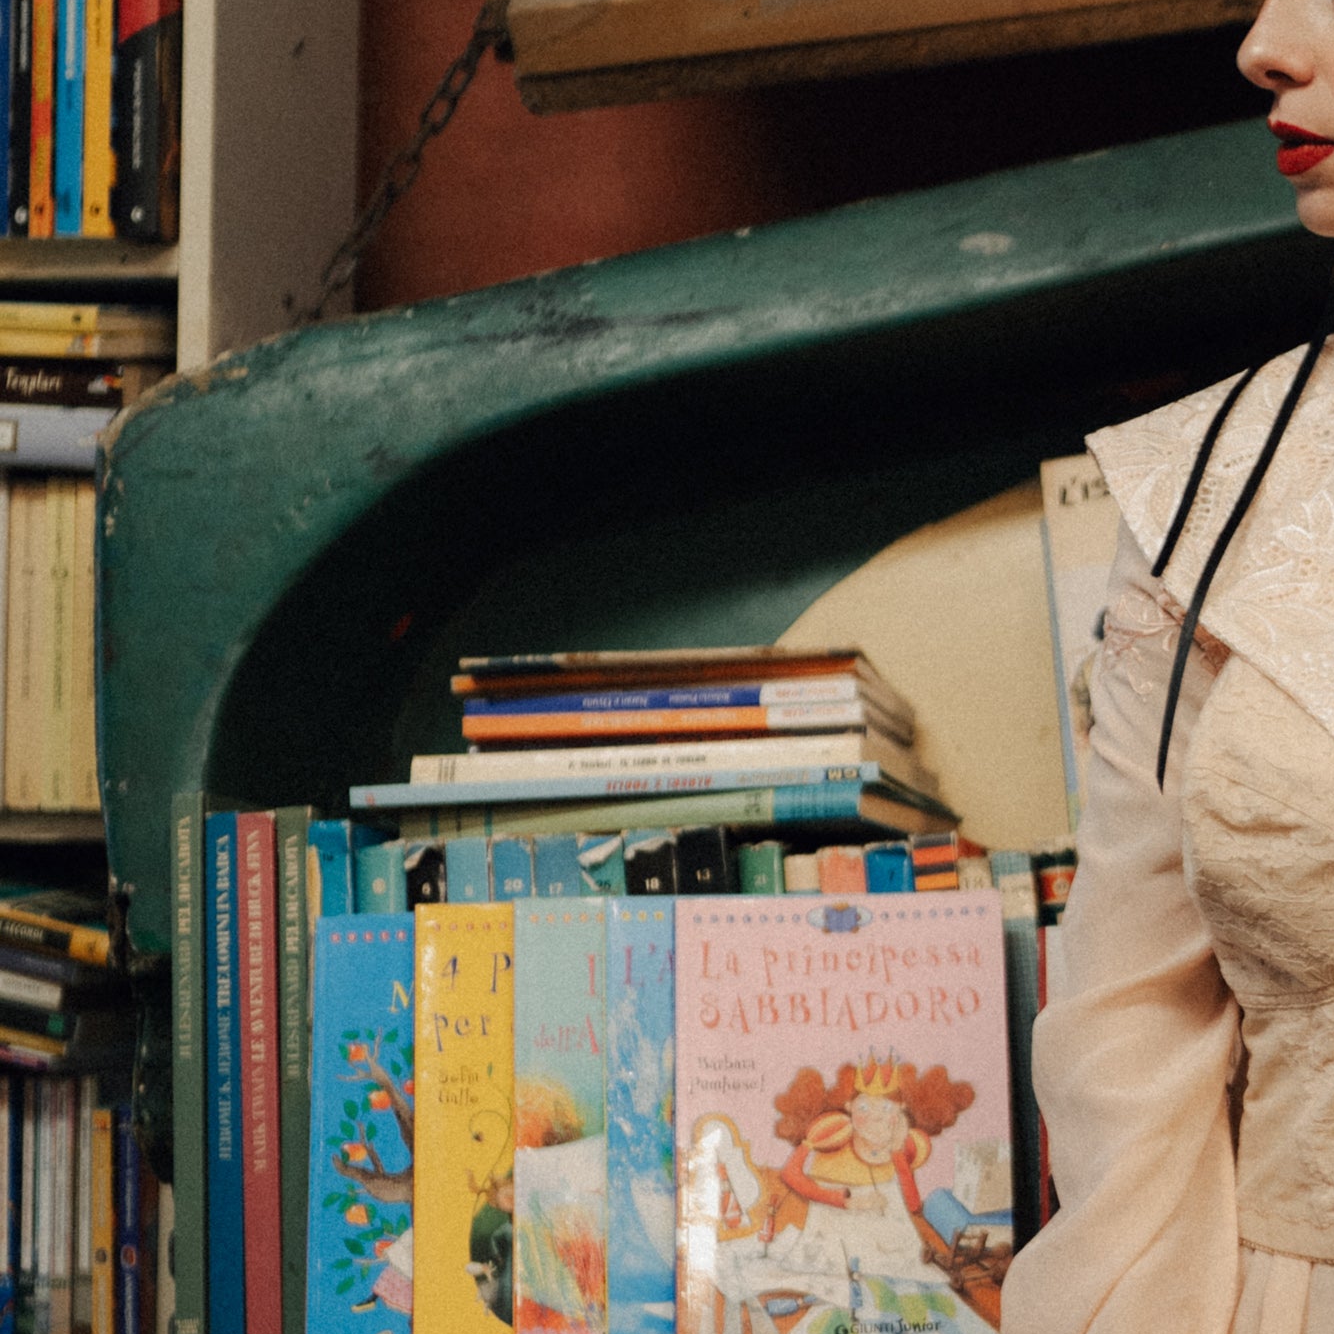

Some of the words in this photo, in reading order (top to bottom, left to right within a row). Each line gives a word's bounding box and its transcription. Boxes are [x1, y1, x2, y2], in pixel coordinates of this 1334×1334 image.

[213, 834, 230, 890] BARCA
[441, 954, 460, 991] 4
[702, 940, 740, 980] La
[762, 942, 982, 988] principessa
[215, 974, 232, 1007] TRE
[700, 986, 982, 1035] SABBIADORO
[249, 1038, 267, 1063] LE
[433, 1012, 491, 1053] per
[850, 1322, 894, 1334] GIUNTI
